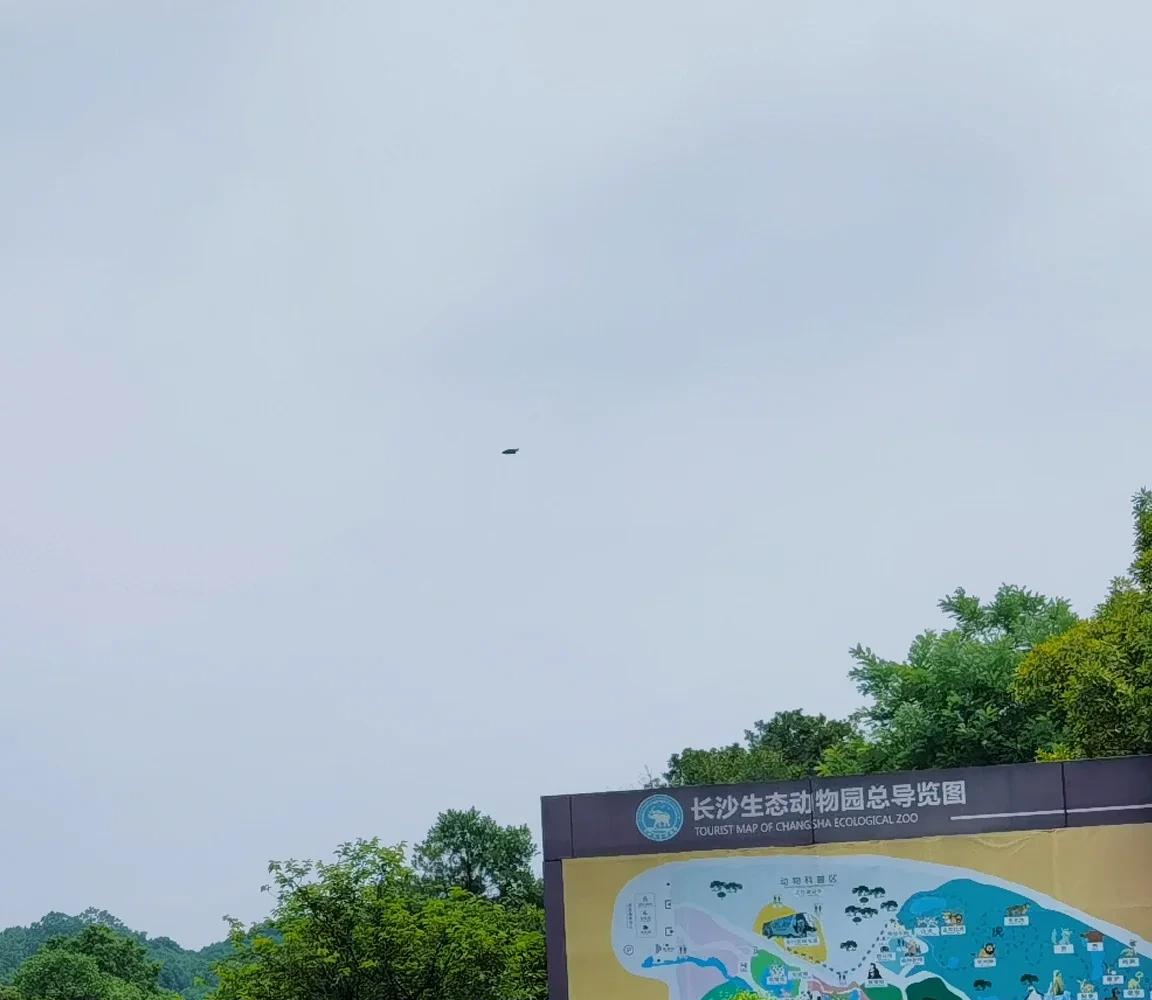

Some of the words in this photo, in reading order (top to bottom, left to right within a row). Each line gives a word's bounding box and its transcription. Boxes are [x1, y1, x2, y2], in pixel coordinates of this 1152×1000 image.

[690, 780, 966, 821] 长沙生态动物园总导览图
[695, 824, 733, 837] TOURIST
[736, 823, 759, 834] MAP
[760, 822, 774, 833] OF
[775, 818, 831, 832] CHANGSHA
[834, 815, 894, 828] ECOLOGICAL
[896, 812, 919, 824] ZOO
